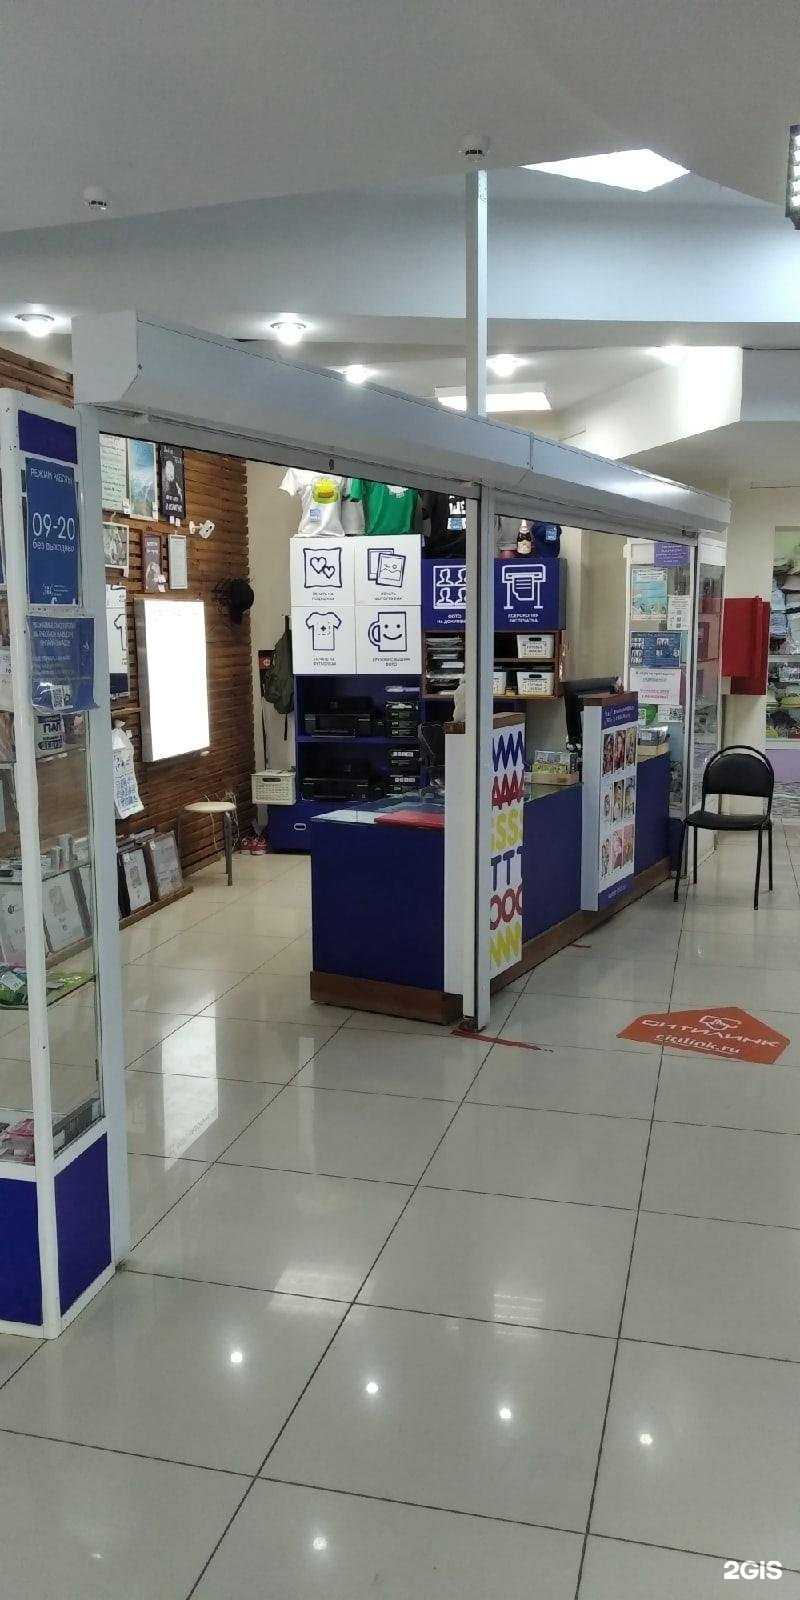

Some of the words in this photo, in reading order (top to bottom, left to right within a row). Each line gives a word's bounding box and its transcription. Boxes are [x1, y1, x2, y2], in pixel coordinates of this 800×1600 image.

[32, 512, 75, 541] 09-20
[641, 1018, 781, 1048] СИТИЛИНК
[653, 1033, 742, 1054] citilink.ru
